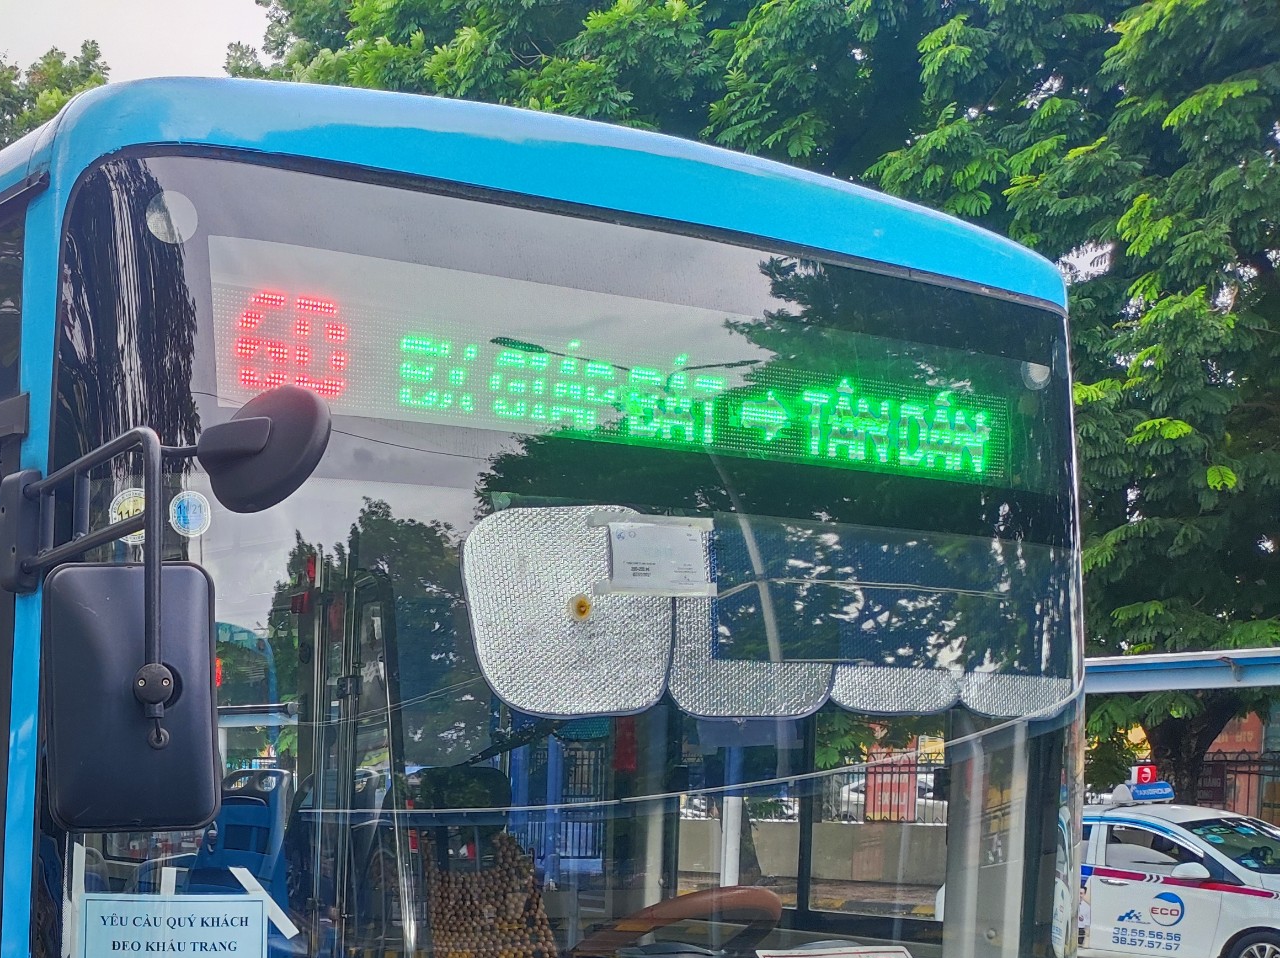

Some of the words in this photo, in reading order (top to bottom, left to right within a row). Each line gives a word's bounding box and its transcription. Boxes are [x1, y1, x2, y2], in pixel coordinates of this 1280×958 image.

[1151, 906, 1180, 916] ECO
[100, 912, 129, 927] YÊU
[166, 913, 197, 930] QUÝ
[200, 913, 249, 928] KHÁCH
[111, 940, 142, 952] ĐEO
[190, 940, 238, 952] TRANG
[1112, 936, 1180, 950] 38.57.57.57
